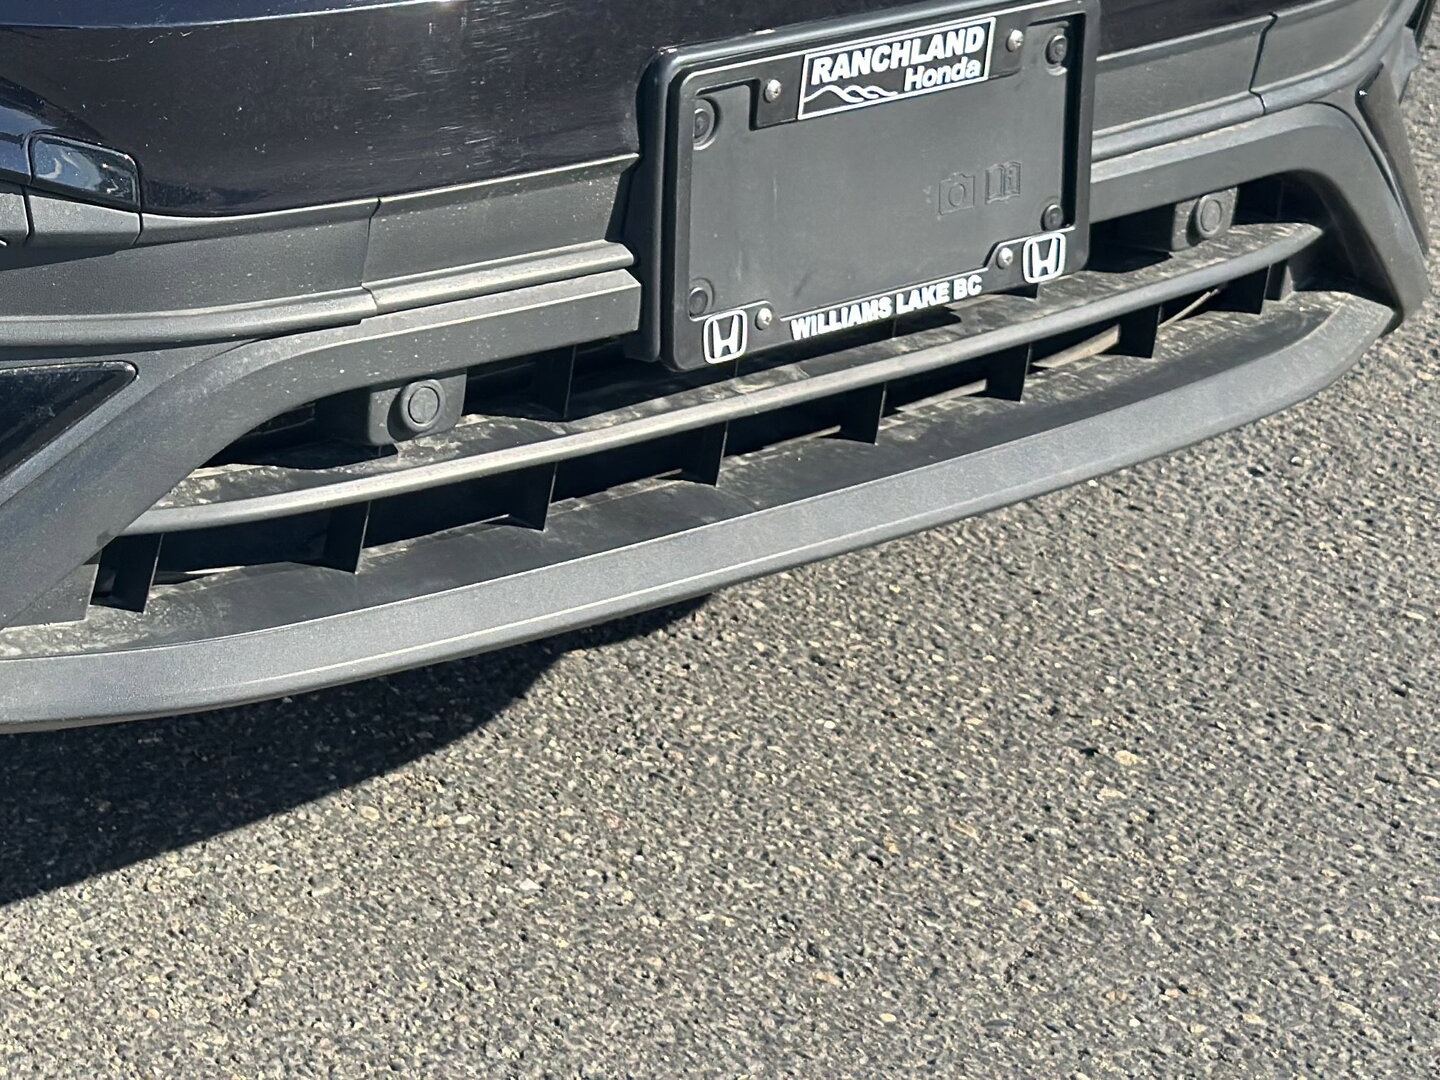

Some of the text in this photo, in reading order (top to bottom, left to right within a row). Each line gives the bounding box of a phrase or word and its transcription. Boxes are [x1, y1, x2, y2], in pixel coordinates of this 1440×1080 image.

[810, 25, 985, 86] RANCHLAND
[903, 56, 982, 92] Honda
[790, 274, 983, 341] WILLIAMS LAKE BC
